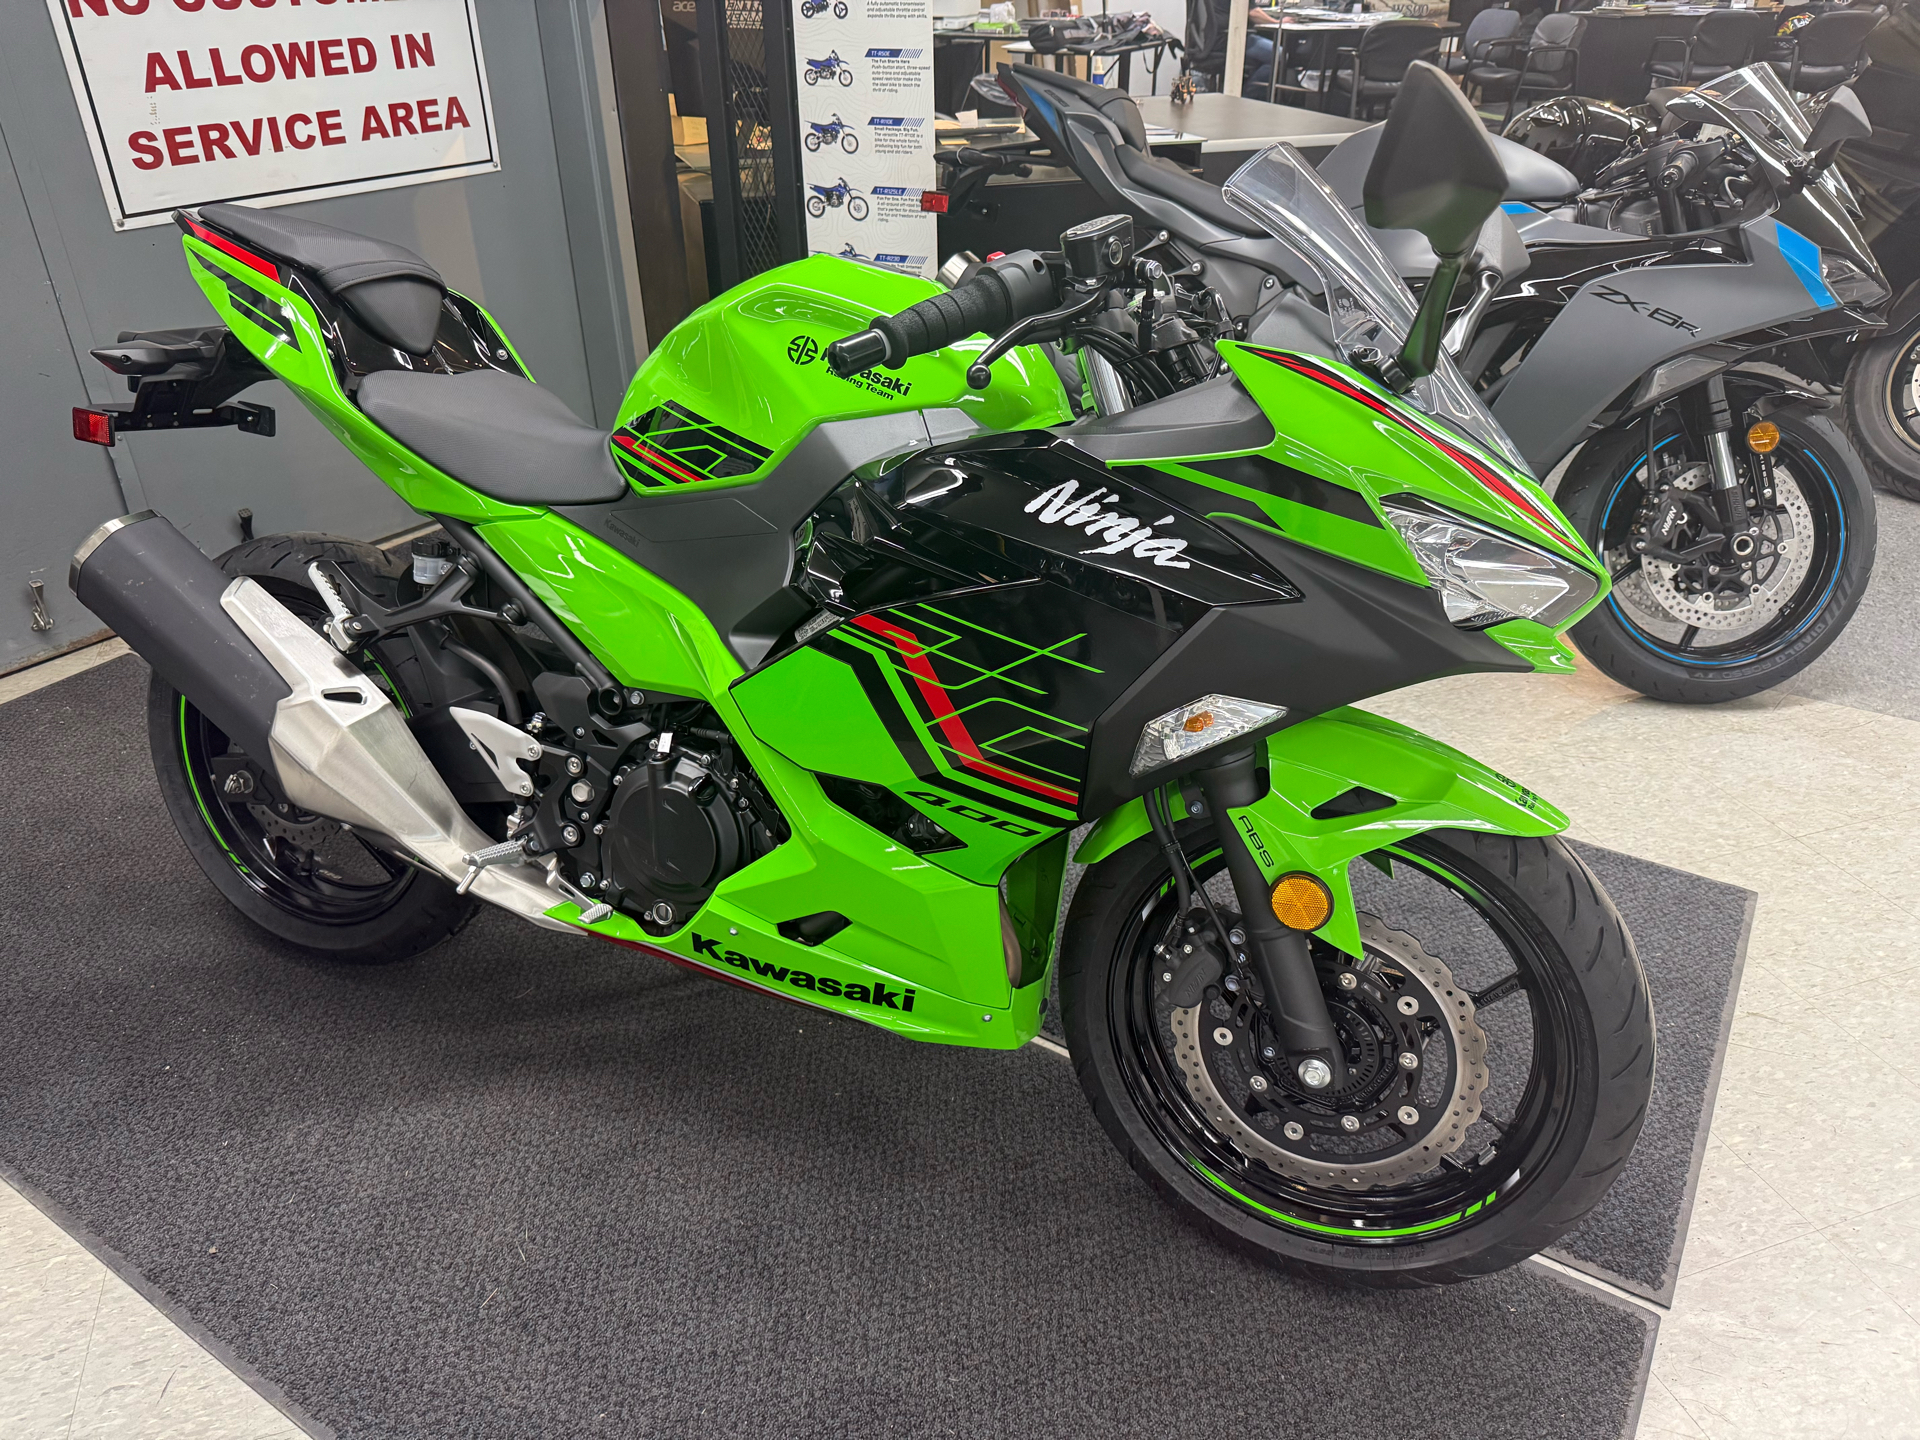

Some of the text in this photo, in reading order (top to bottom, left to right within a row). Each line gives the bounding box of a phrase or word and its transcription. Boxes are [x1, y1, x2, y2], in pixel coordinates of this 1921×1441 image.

[144, 32, 435, 94] ALLOWED IN
[128, 96, 471, 171] SERVICE AREA
[1588, 284, 1701, 339] ZX-6R
[866, 381, 895, 401] Team
[603, 517, 641, 548] Kawasaki
[1024, 479, 1190, 570] Ninja
[1775, 622, 1826, 663] DIABLO
[903, 790, 1042, 838] 400
[1238, 815, 1275, 868] ABS
[691, 932, 916, 1013] Kawasaki
